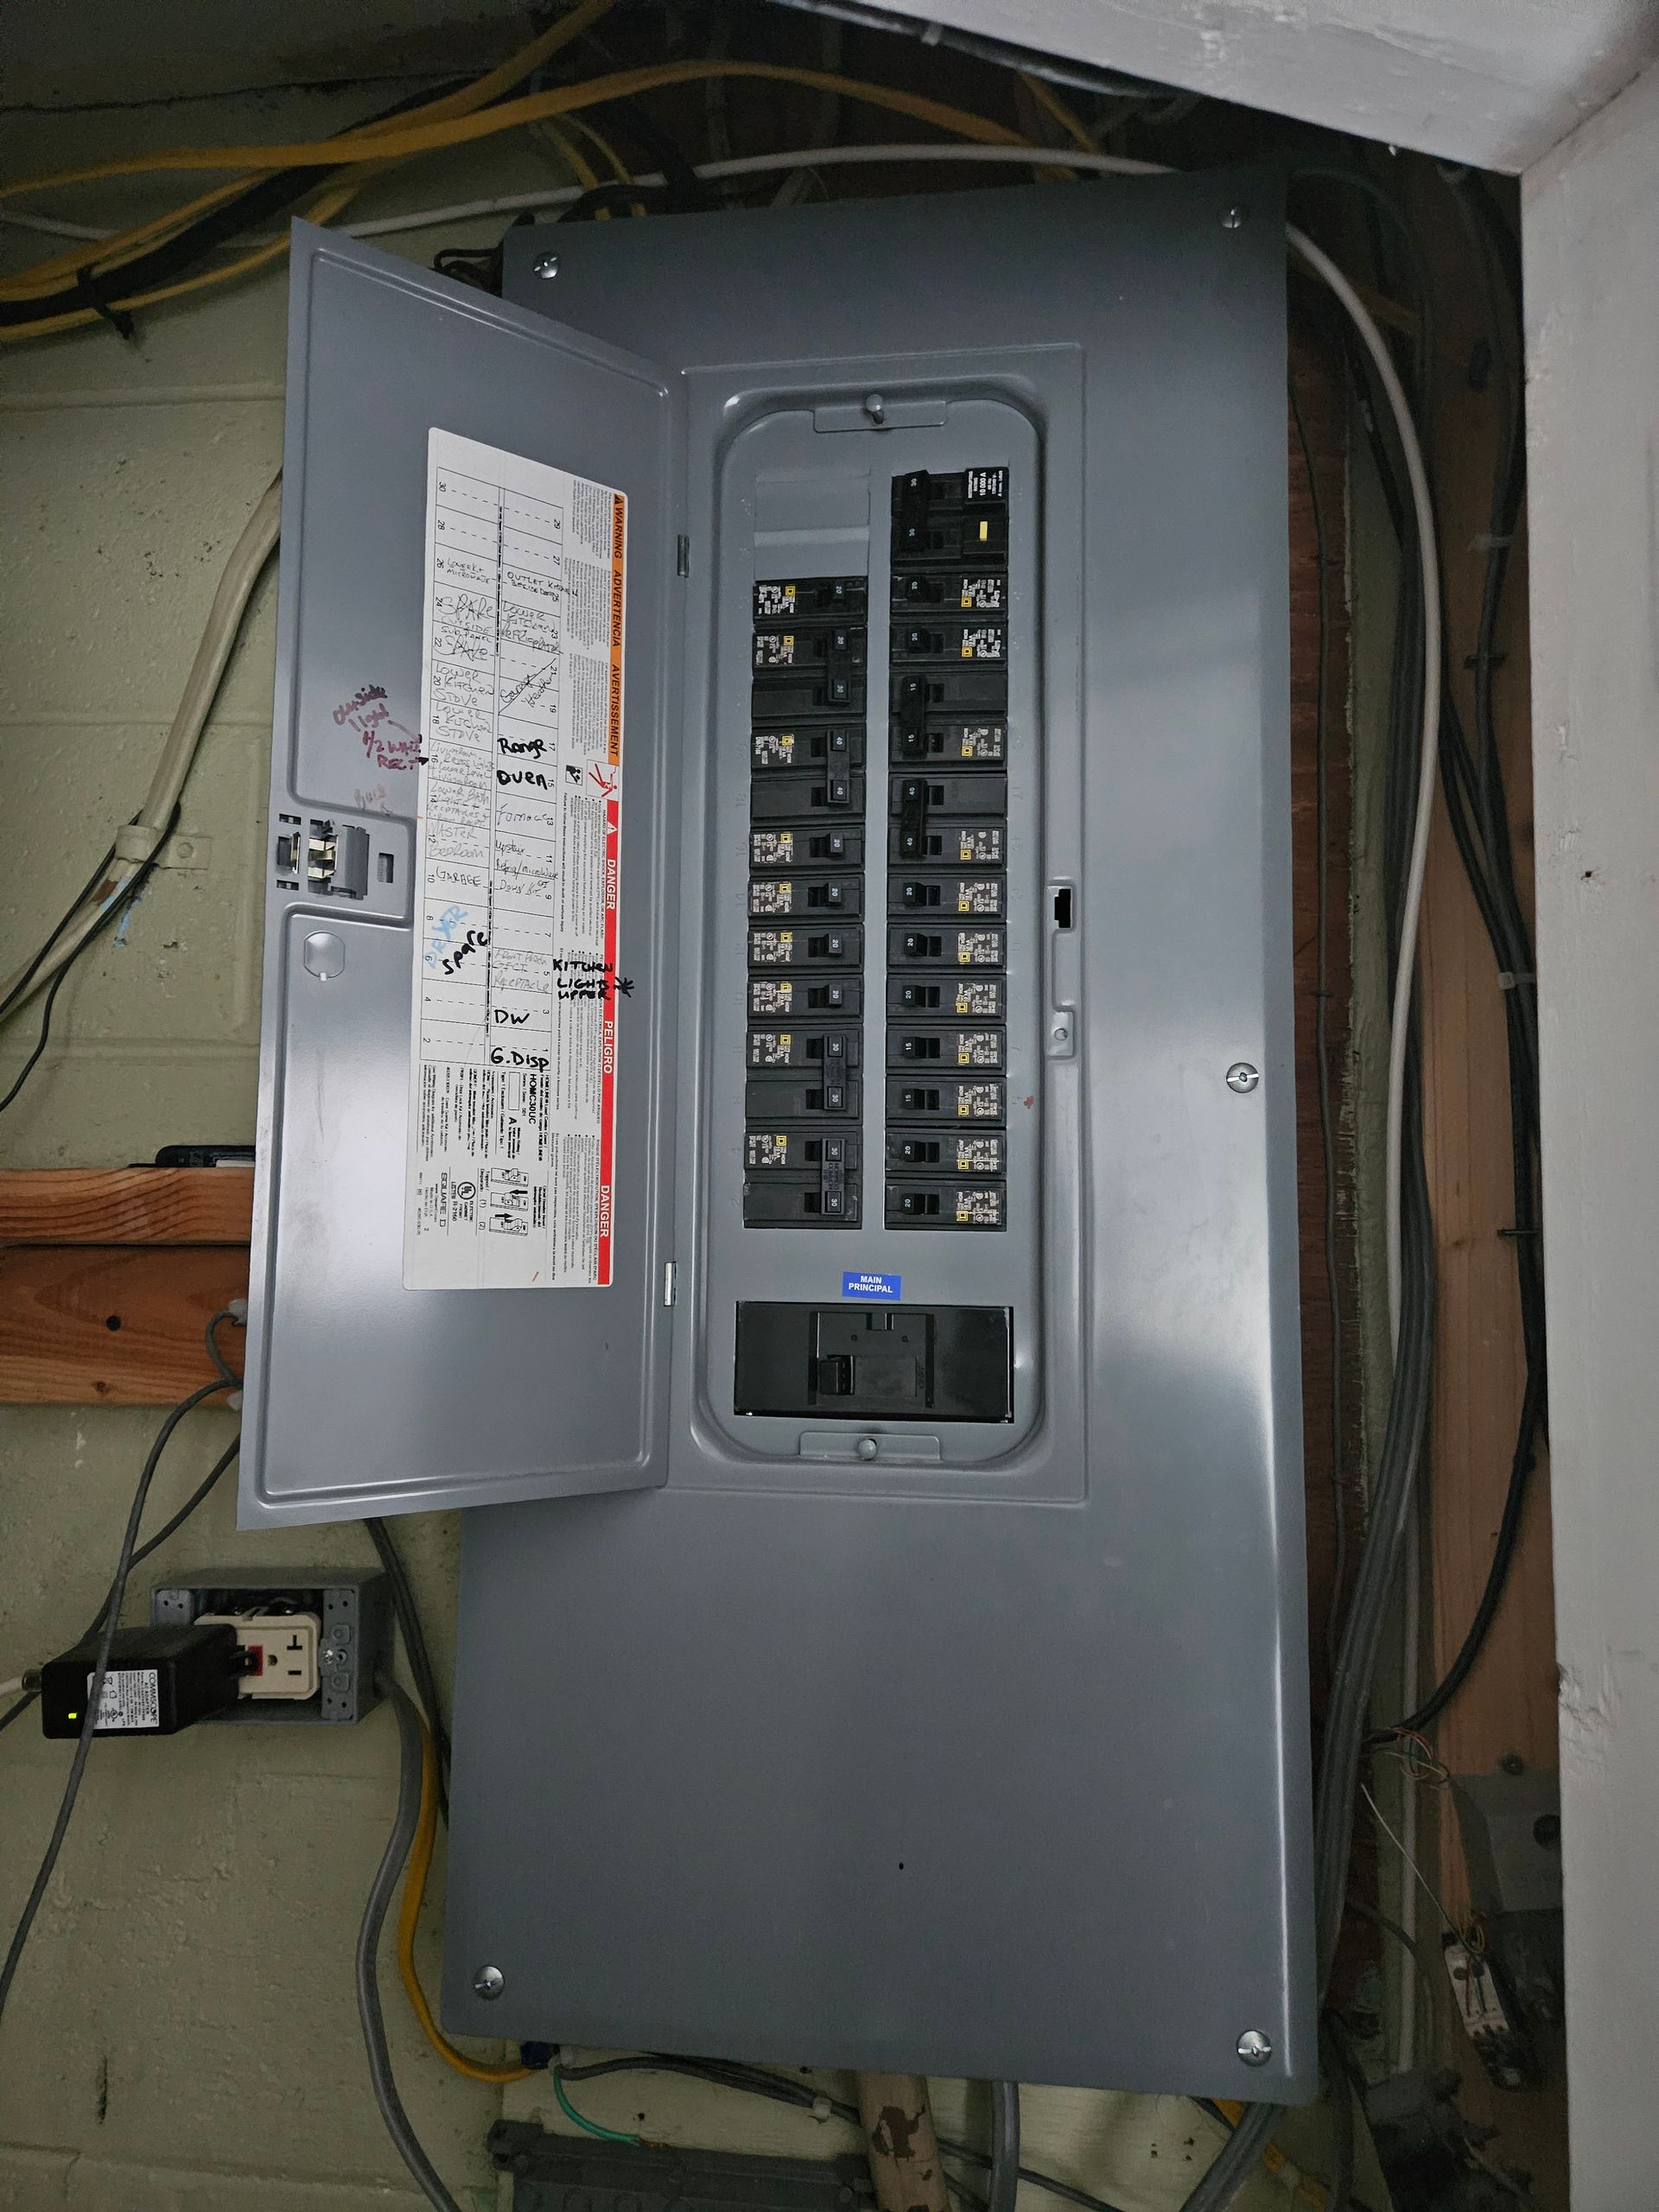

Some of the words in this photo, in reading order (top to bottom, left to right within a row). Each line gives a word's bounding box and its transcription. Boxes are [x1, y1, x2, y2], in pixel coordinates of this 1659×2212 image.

[438, 481, 447, 493] 30
[437, 519, 445, 531] 28
[553, 518, 561, 530] 29
[614, 507, 623, 560] WARNING
[553, 555, 560, 566] 27
[506, 571, 543, 586] OUTLET
[552, 593, 559, 602] 25
[612, 569, 622, 647] ADVERTENCIA
[551, 630, 558, 639] 23
[435, 637, 442, 648] 22
[550, 665, 557, 675] 21
[434, 676, 441, 686] 20
[550, 704, 557, 713] 19
[610, 664, 621, 757] AVERTISSEMENT
[432, 715, 440, 725] 18
[497, 738, 548, 760] Range
[549, 742, 556, 751] 17
[431, 754, 439, 763] 16
[547, 779, 555, 788] 15
[836, 786, 843, 795] 40
[909, 786, 915, 796] 40
[547, 817, 554, 826] 13
[428, 834, 436, 843] 12
[834, 838, 840, 848] 20
[907, 837, 913, 847] 40
[546, 855, 553, 863] 11
[427, 874, 435, 883] 10
[606, 859, 616, 911] DANGER
[831, 887, 838, 897] 20
[906, 887, 912, 896] 20
[832, 939, 839, 949] 20
[907, 938, 913, 947] 20
[832, 989, 839, 999] 20
[906, 989, 912, 999] 20
[494, 1009, 530, 1025] DW
[604, 1020, 613, 1074] PELIGRO
[832, 1042, 839, 1052] 30
[906, 1042, 912, 1051] 15
[529, 1073, 537, 1124] HOMC30UC
[832, 1093, 838, 1103] 30
[906, 1094, 912, 1103] 15
[509, 1116, 518, 1125] A
[831, 1147, 838, 1156] 30
[905, 1146, 911, 1155] 20
[831, 1198, 838, 1207] 30
[904, 1198, 911, 1208] 20
[600, 1185, 610, 1238] DANGER
[439, 1218, 447, 1228] D
[860, 1274, 882, 1284] MAIN
[848, 1282, 893, 1294] PRINCIPAL
[149, 1672, 157, 1722] COMMSCOPE
